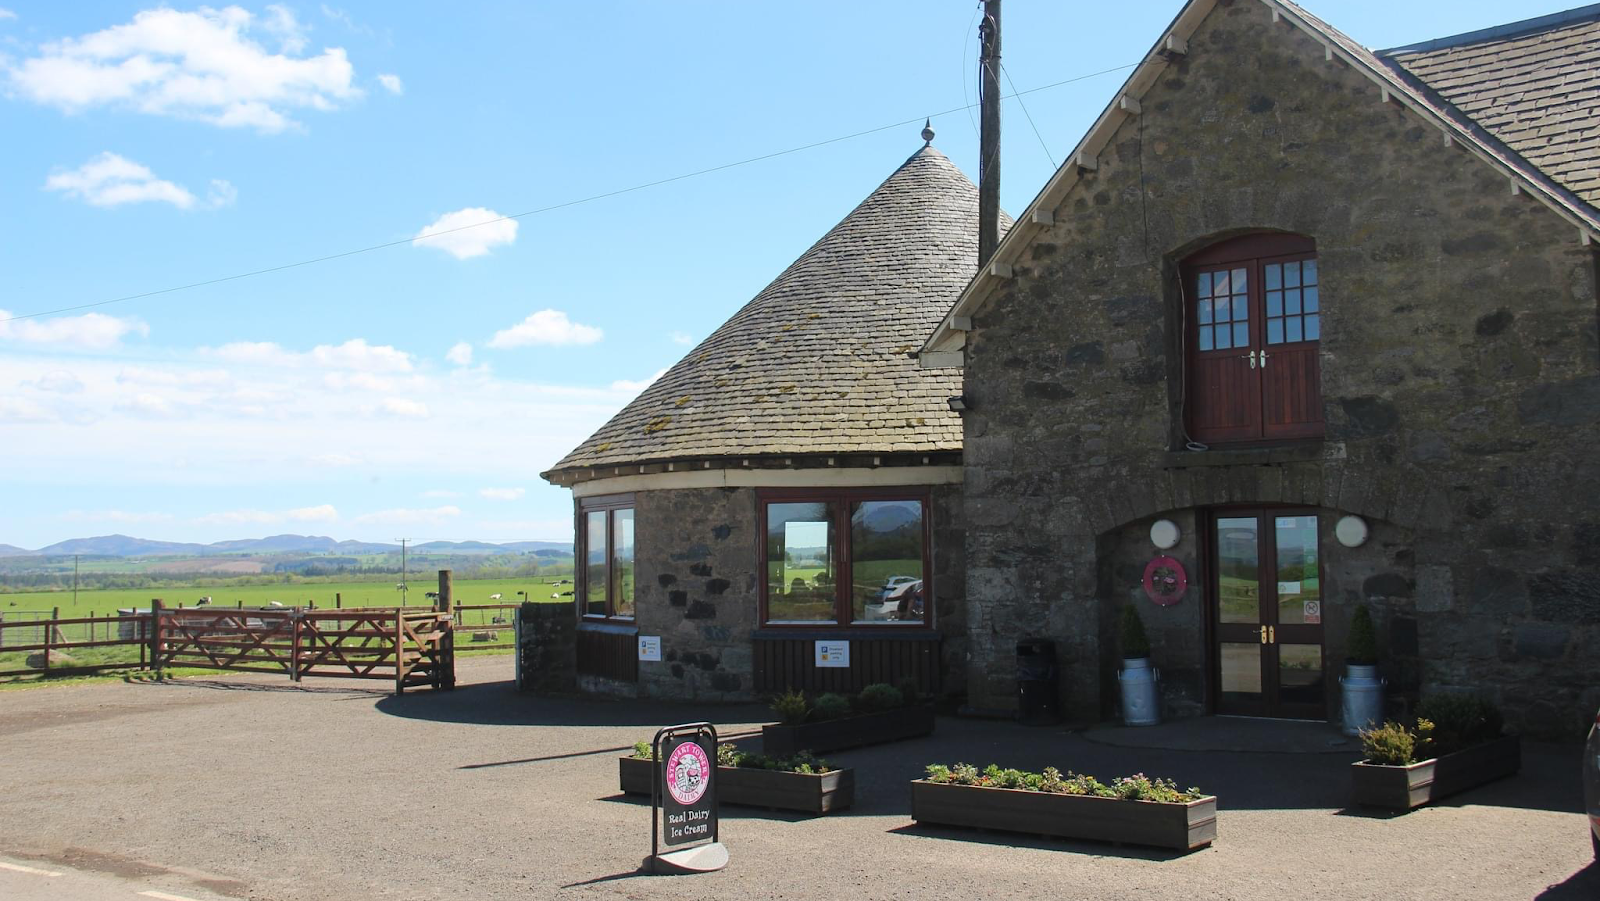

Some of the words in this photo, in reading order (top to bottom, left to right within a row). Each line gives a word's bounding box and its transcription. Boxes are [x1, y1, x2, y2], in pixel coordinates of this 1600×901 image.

[669, 746, 690, 778] STEWART
[692, 746, 708, 774] TOWER
[678, 791, 700, 802] DAIRY
[669, 811, 686, 824] Real
[688, 809, 710, 821] Dairy
[671, 827, 683, 838] Ice
[684, 823, 707, 835] Cream
